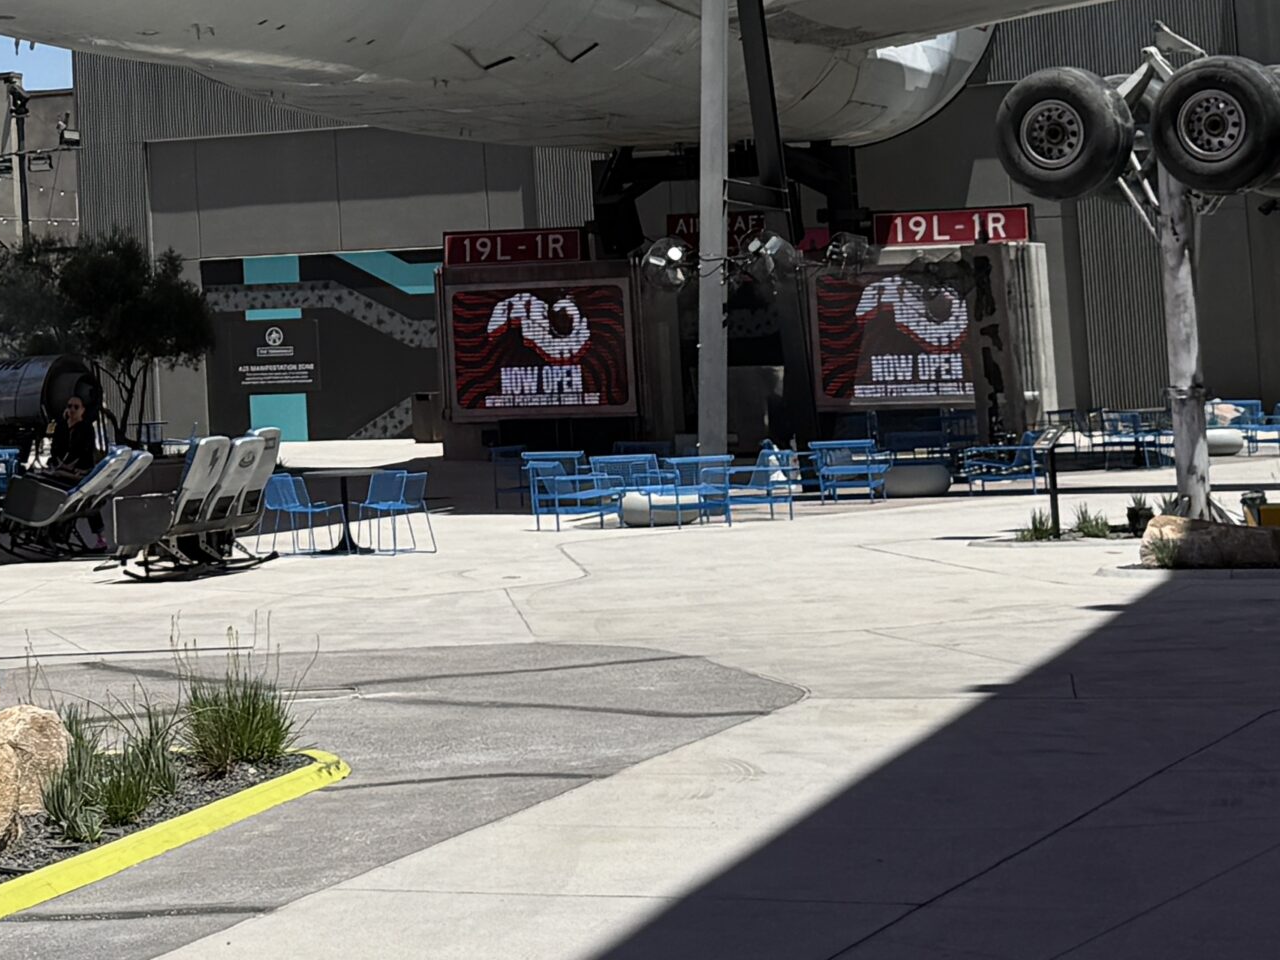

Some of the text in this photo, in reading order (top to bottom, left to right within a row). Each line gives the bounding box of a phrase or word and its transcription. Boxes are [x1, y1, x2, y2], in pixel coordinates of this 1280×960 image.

[463, 234, 565, 263] 19L-1R
[501, 364, 583, 395] NOW OPEN
[871, 353, 963, 381] NOW OPEN
